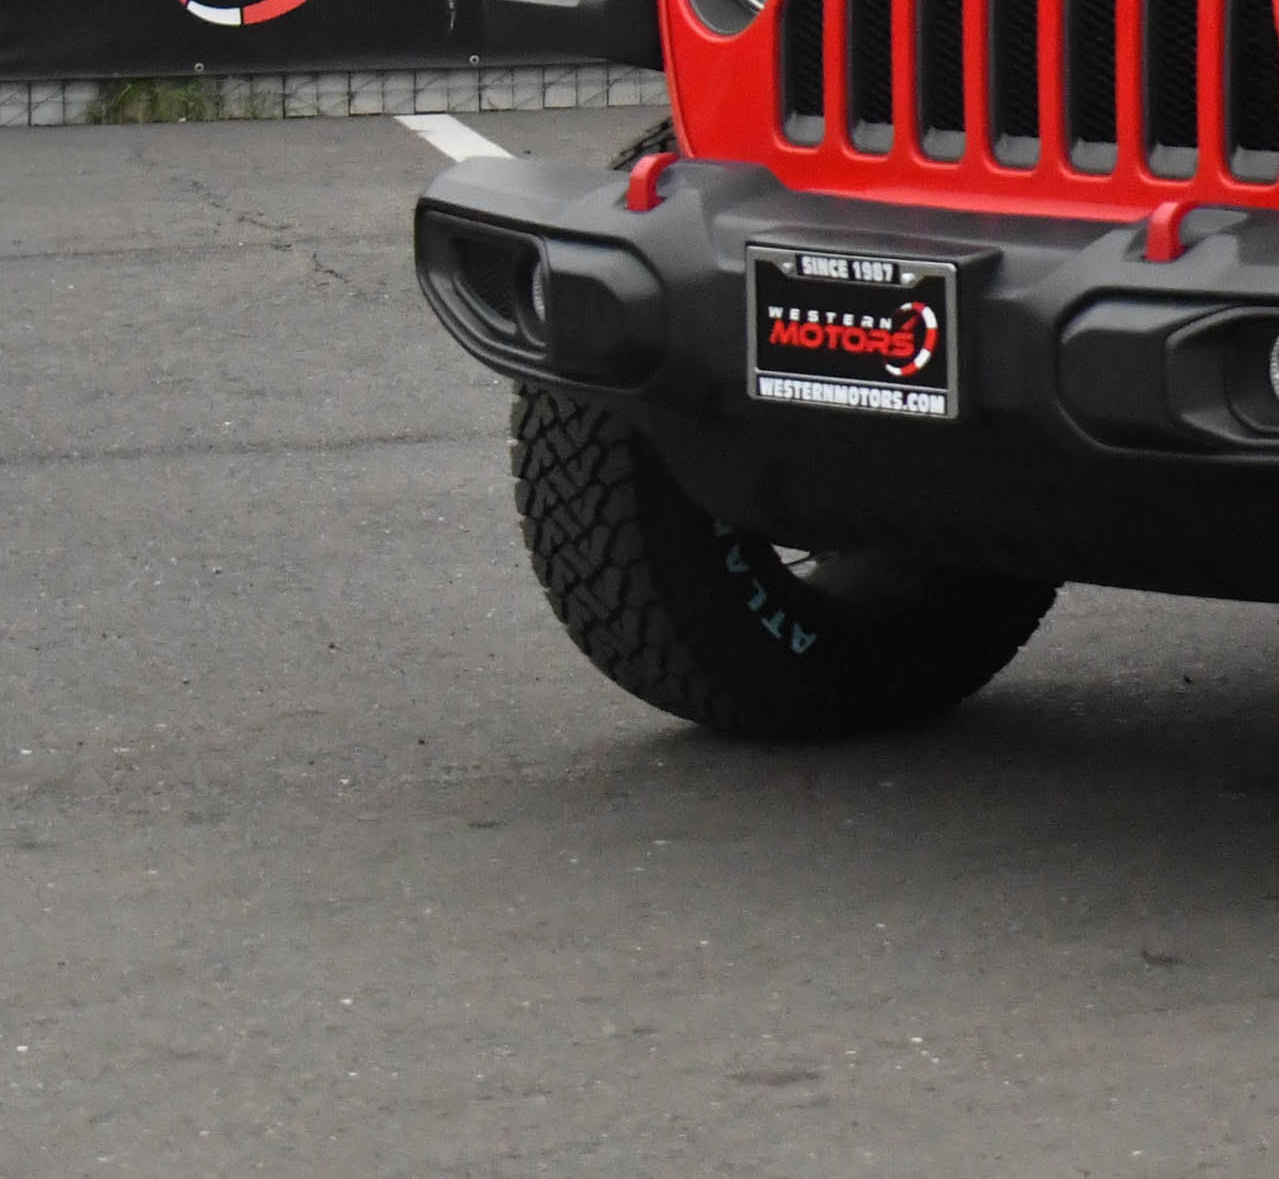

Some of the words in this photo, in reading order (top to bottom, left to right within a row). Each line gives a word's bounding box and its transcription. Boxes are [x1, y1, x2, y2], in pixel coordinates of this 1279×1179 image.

[801, 256, 849, 279] SINCE
[852, 261, 894, 282] 1987
[768, 306, 893, 330] WESTERN
[769, 318, 916, 358] MOTORS
[759, 376, 945, 415] WESTERNMOTORS.COM
